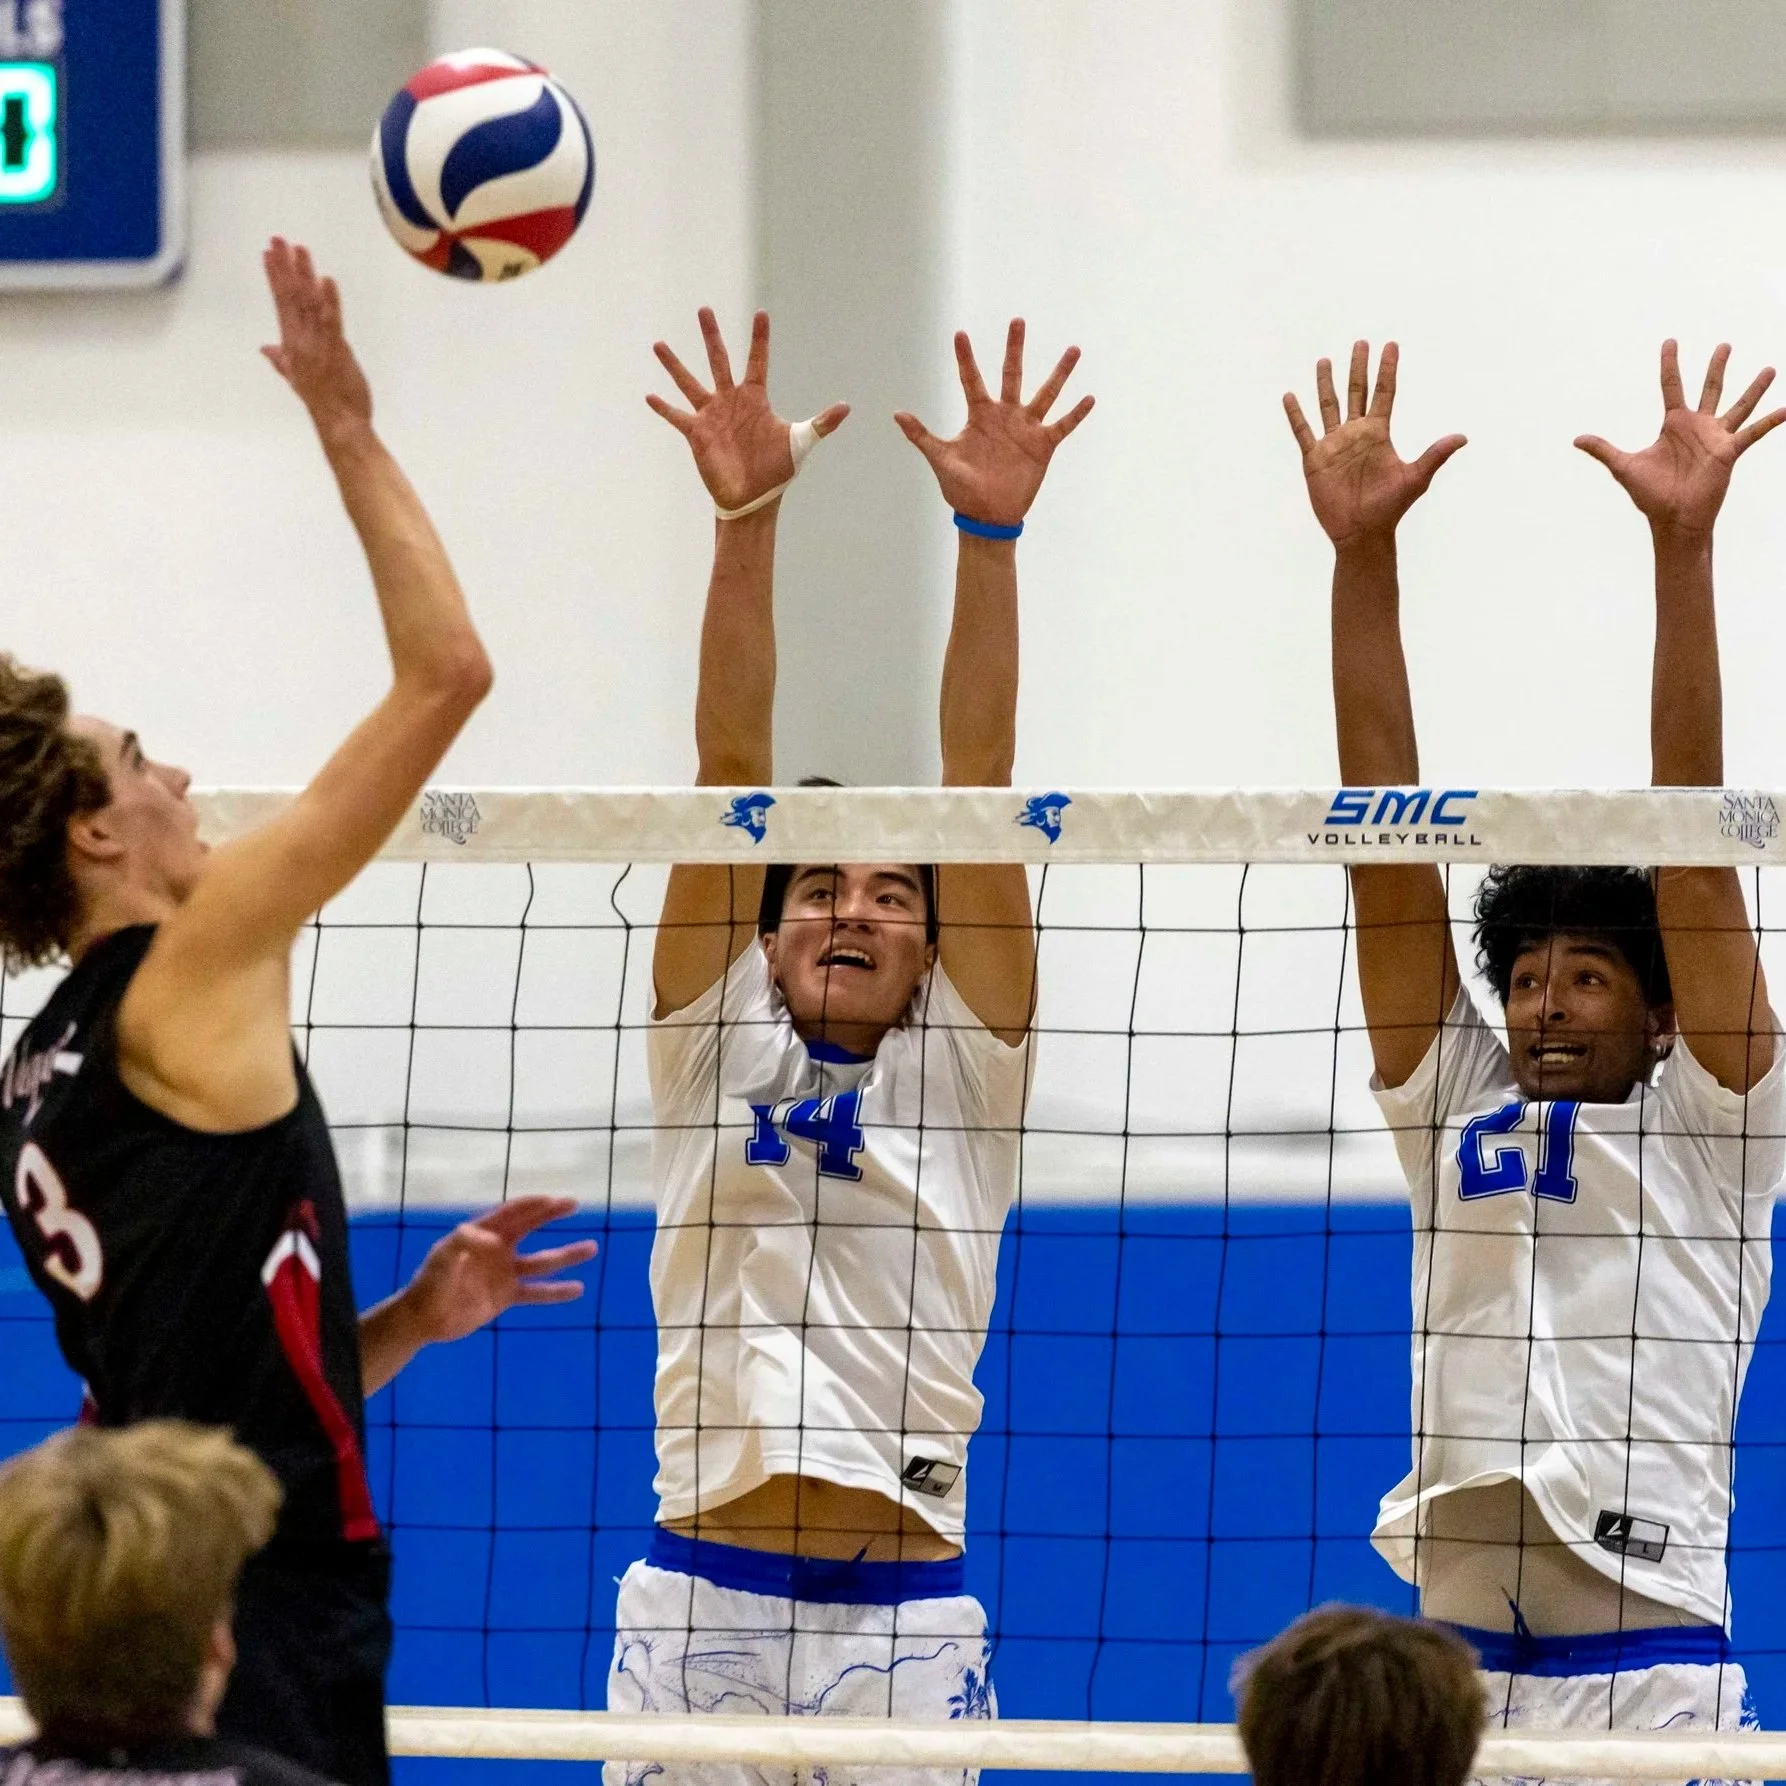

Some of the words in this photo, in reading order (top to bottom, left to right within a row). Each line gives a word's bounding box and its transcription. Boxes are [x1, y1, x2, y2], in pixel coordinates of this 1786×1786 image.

[424, 791, 477, 808] SANTA
[1324, 789, 1479, 825] SMC
[1723, 794, 1775, 810] SANTA
[420, 807, 482, 821] MONICA
[1718, 810, 1780, 824] MONICA
[1307, 833, 1482, 846] VOLLEYBALL
[1721, 823, 1778, 848] COLLEGE
[745, 1086, 865, 1182] 14
[1456, 1099, 1582, 1204] 21
[15, 1141, 103, 1301] 3
